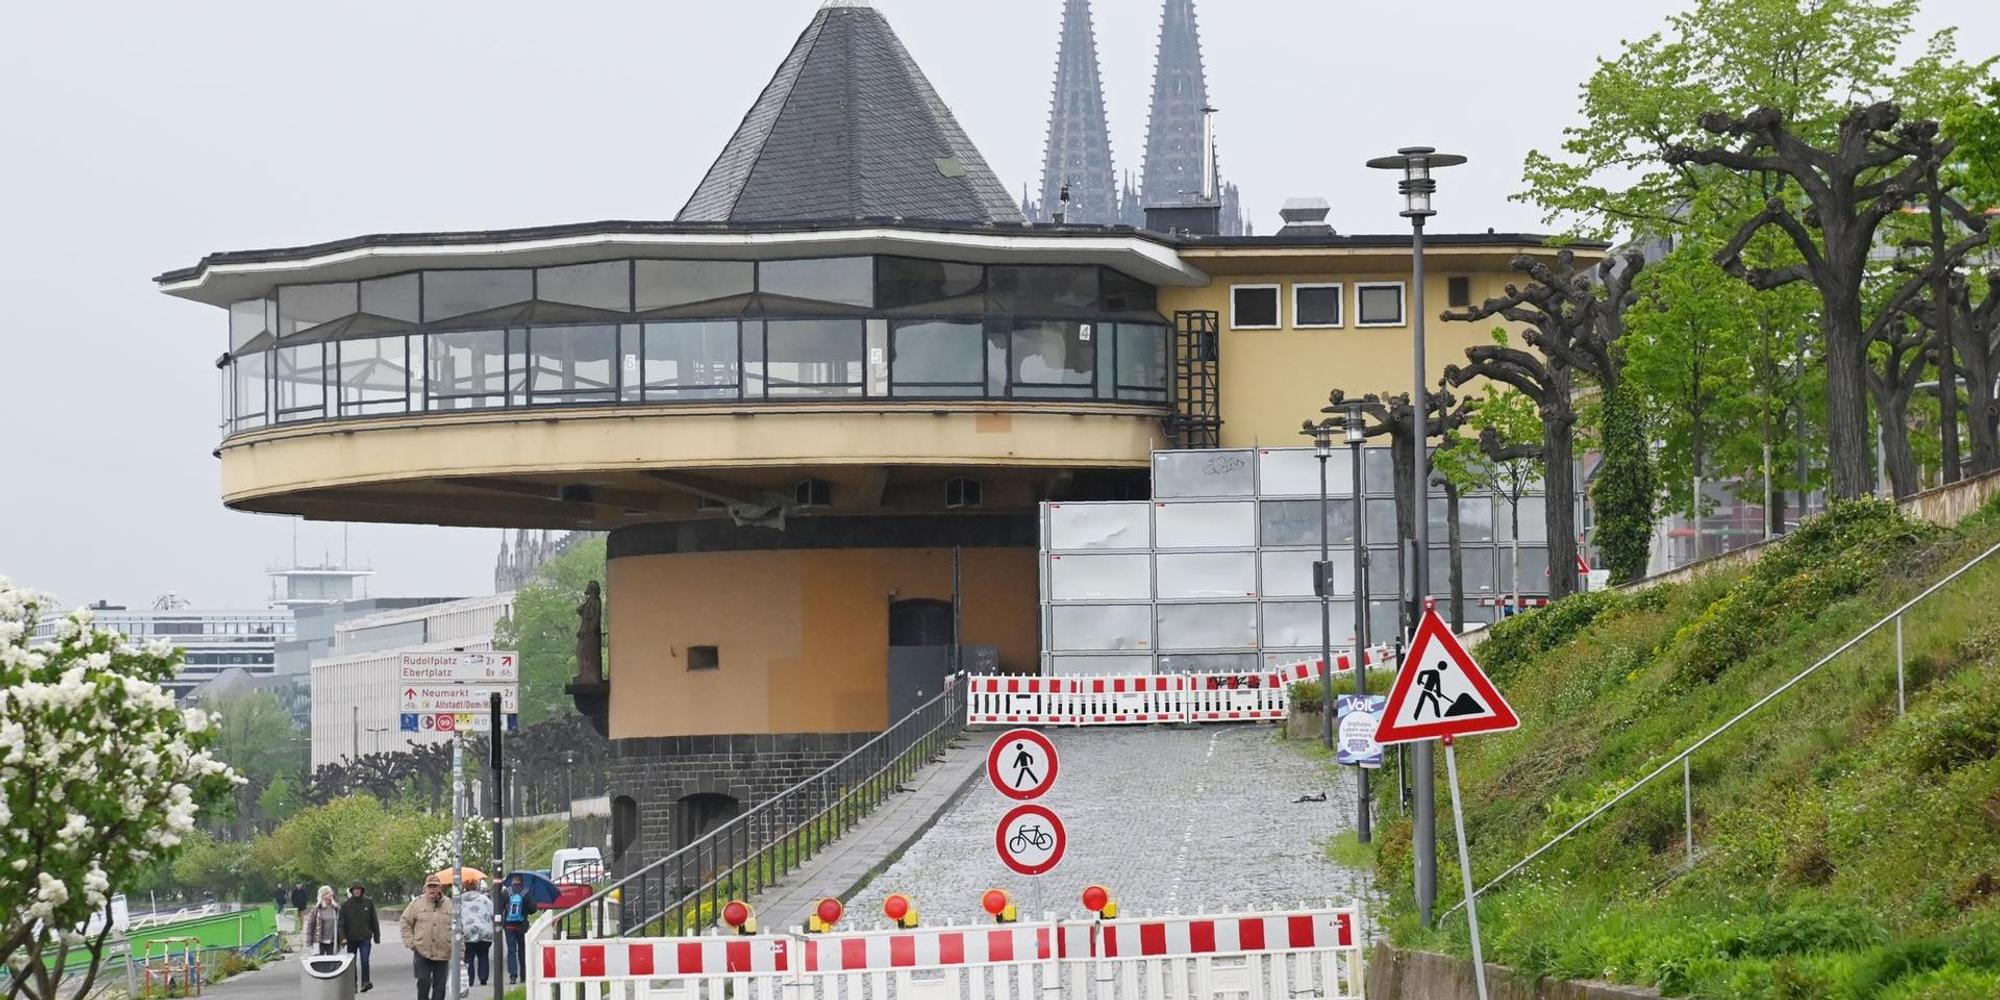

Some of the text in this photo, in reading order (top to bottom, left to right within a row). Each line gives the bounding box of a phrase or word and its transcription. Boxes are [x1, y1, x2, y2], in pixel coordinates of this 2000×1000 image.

[403, 656, 457, 666] Rudolfplatz
[403, 667, 452, 677] Ebertplatz
[422, 689, 469, 697] Neumarkt
[1346, 698, 1375, 711] Volt
